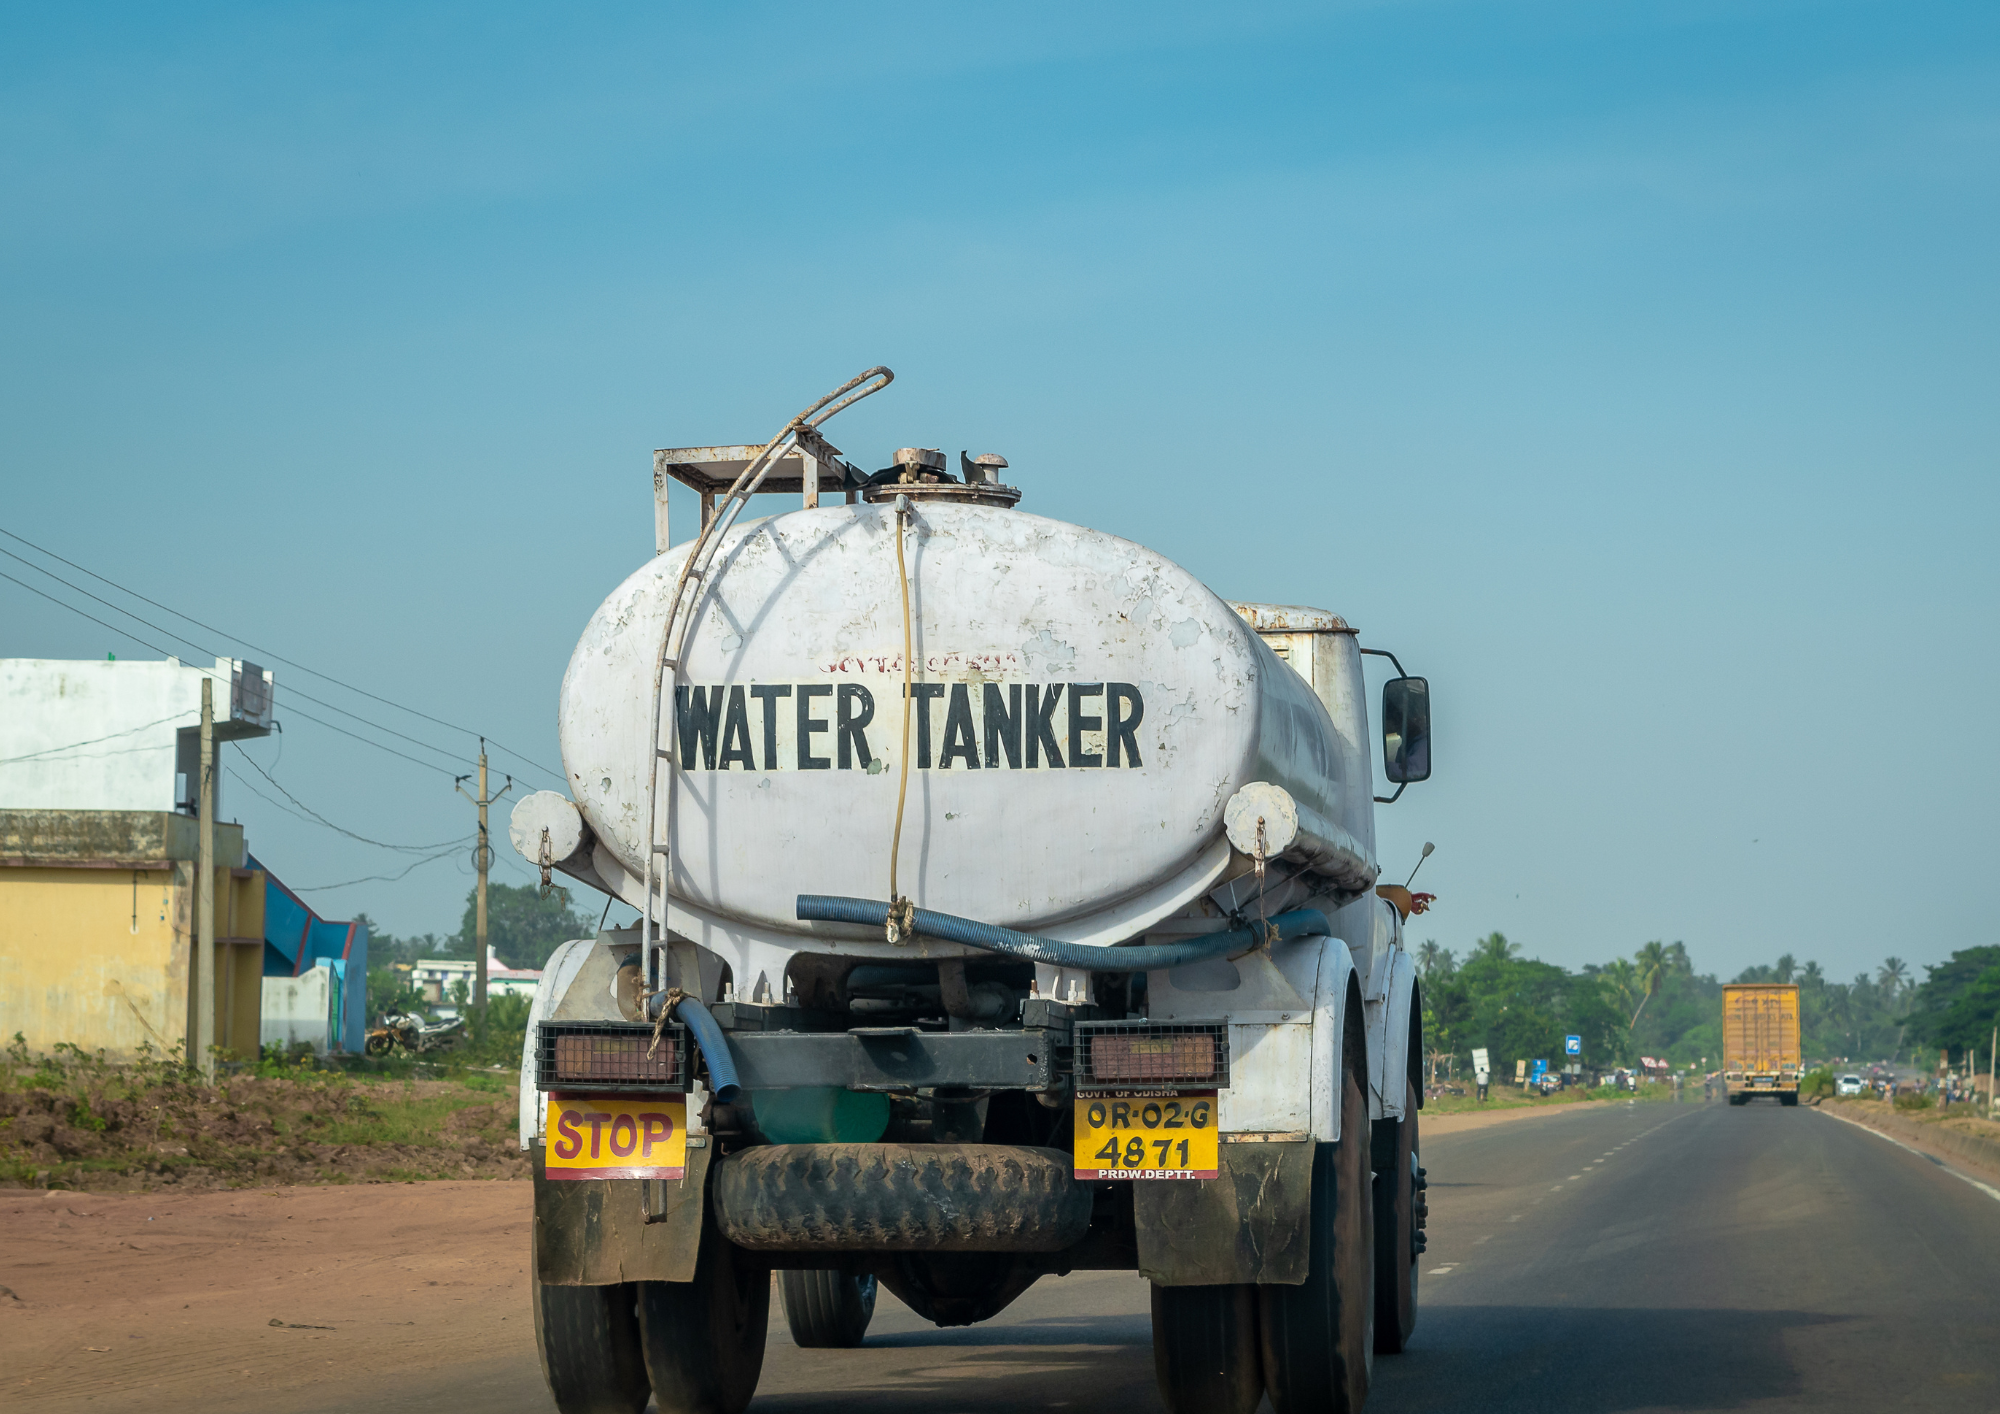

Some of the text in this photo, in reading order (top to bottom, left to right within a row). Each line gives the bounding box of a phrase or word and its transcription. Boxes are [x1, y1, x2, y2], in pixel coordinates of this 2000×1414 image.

[675, 682, 1144, 771] WATER TANKER
[554, 1110, 673, 1159] STOP
[1094, 1136, 1190, 1169] 4871
